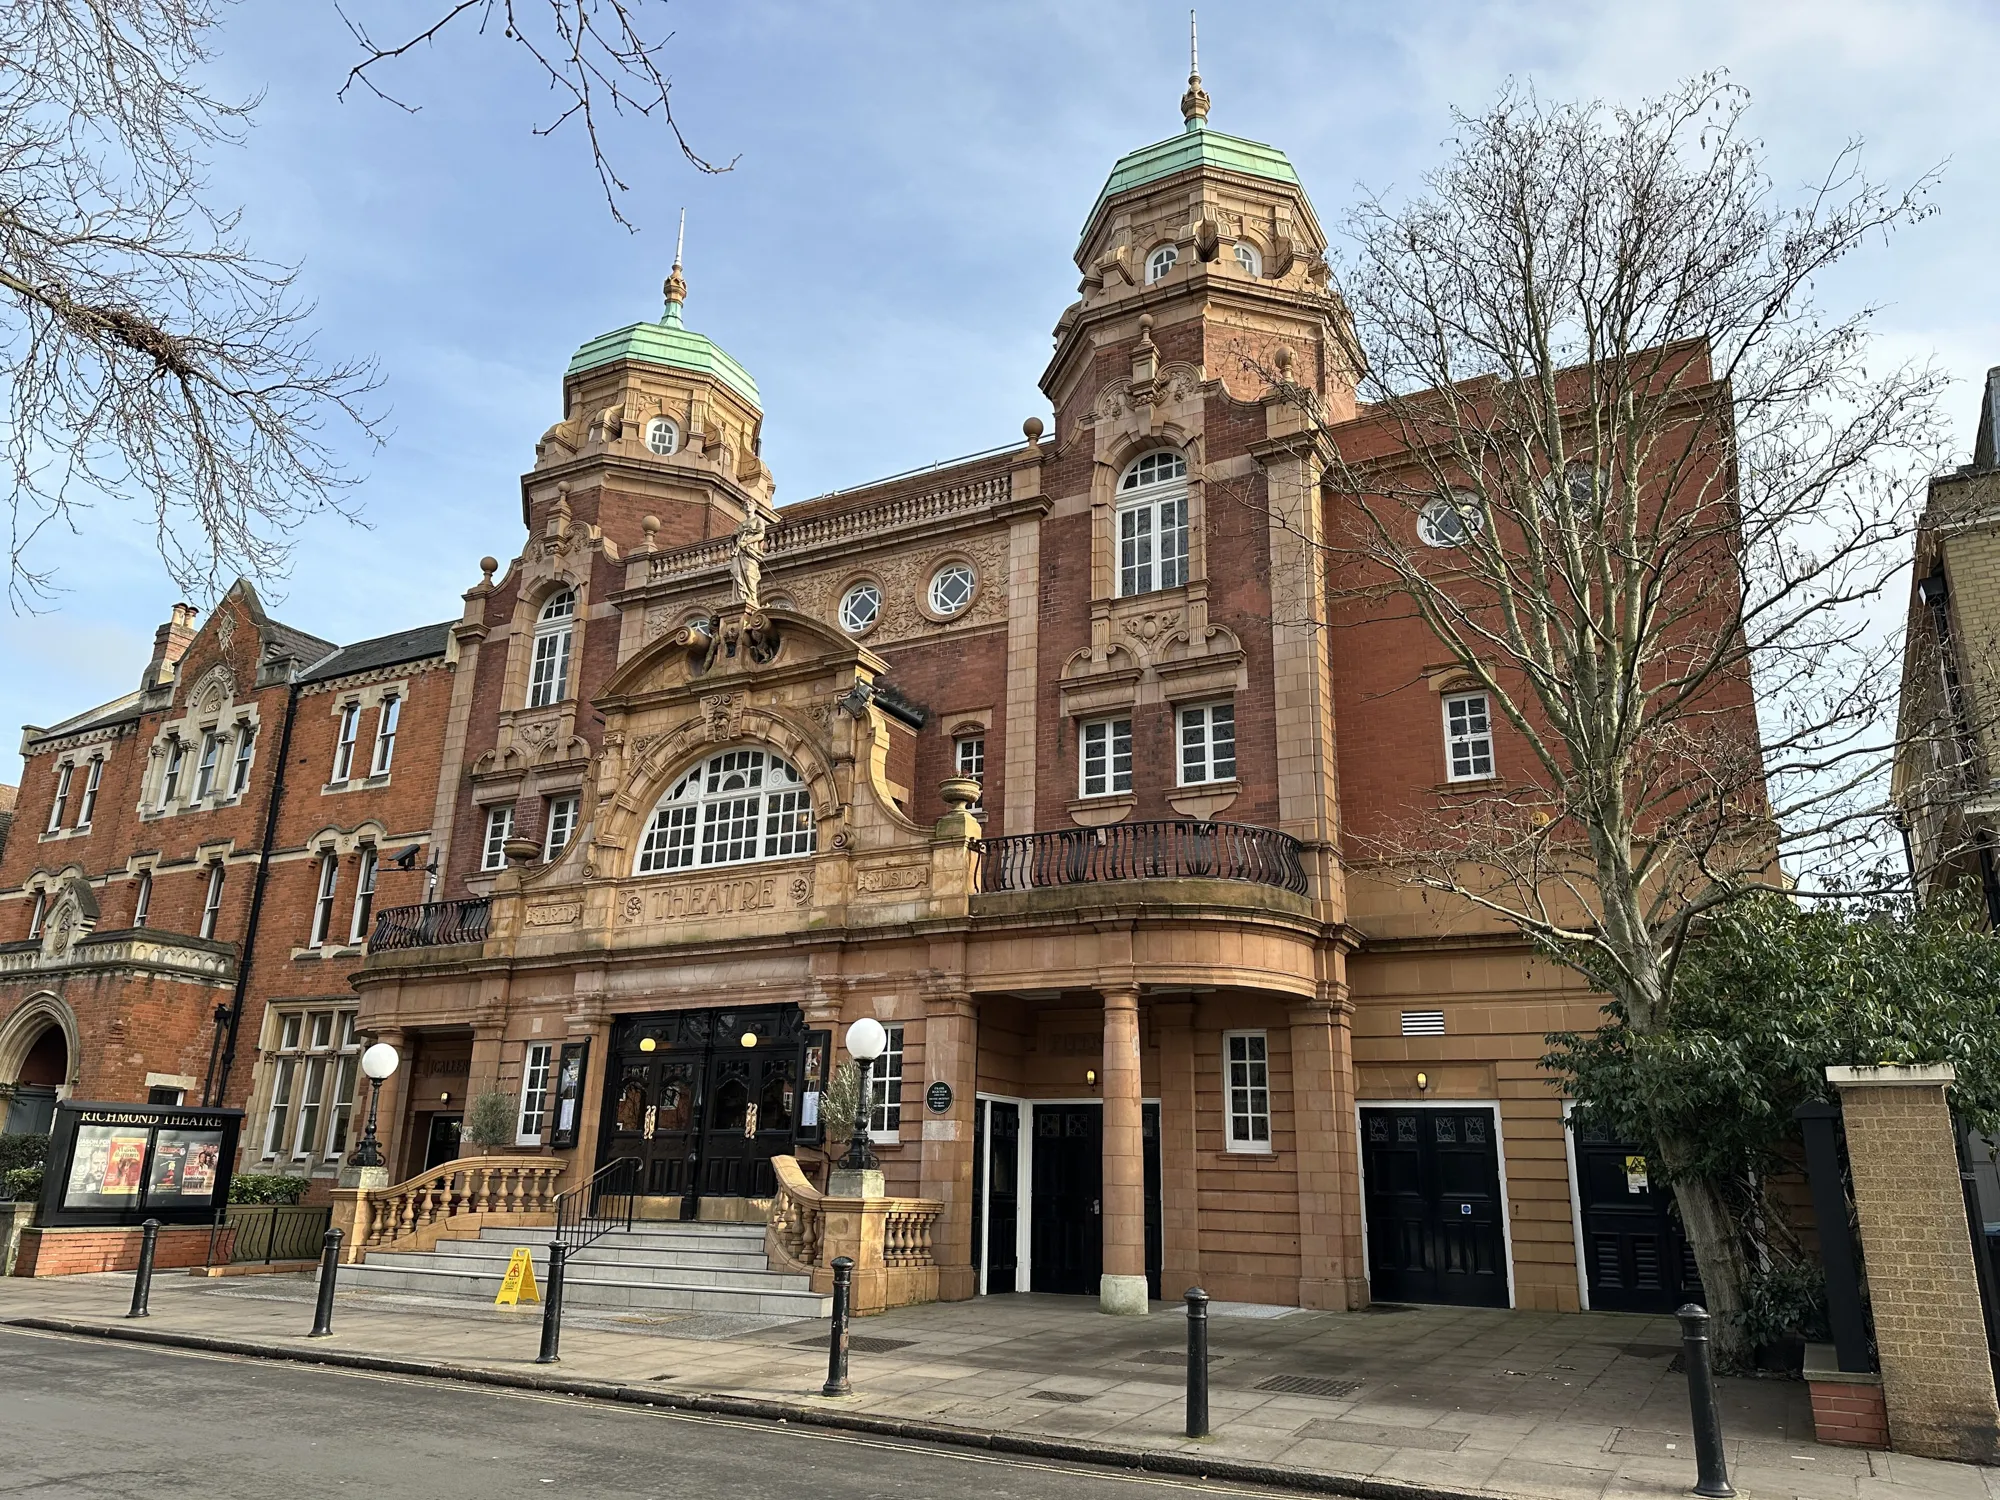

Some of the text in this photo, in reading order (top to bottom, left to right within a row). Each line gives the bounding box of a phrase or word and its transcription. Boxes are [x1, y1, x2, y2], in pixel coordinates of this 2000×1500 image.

[871, 870, 913, 890] MUSIC
[653, 877, 777, 919] THEATRE
[539, 905, 570, 924] ART
[434, 1059, 469, 1074] GALLER
[81, 1111, 222, 1127] RICHMOND THEATRE
